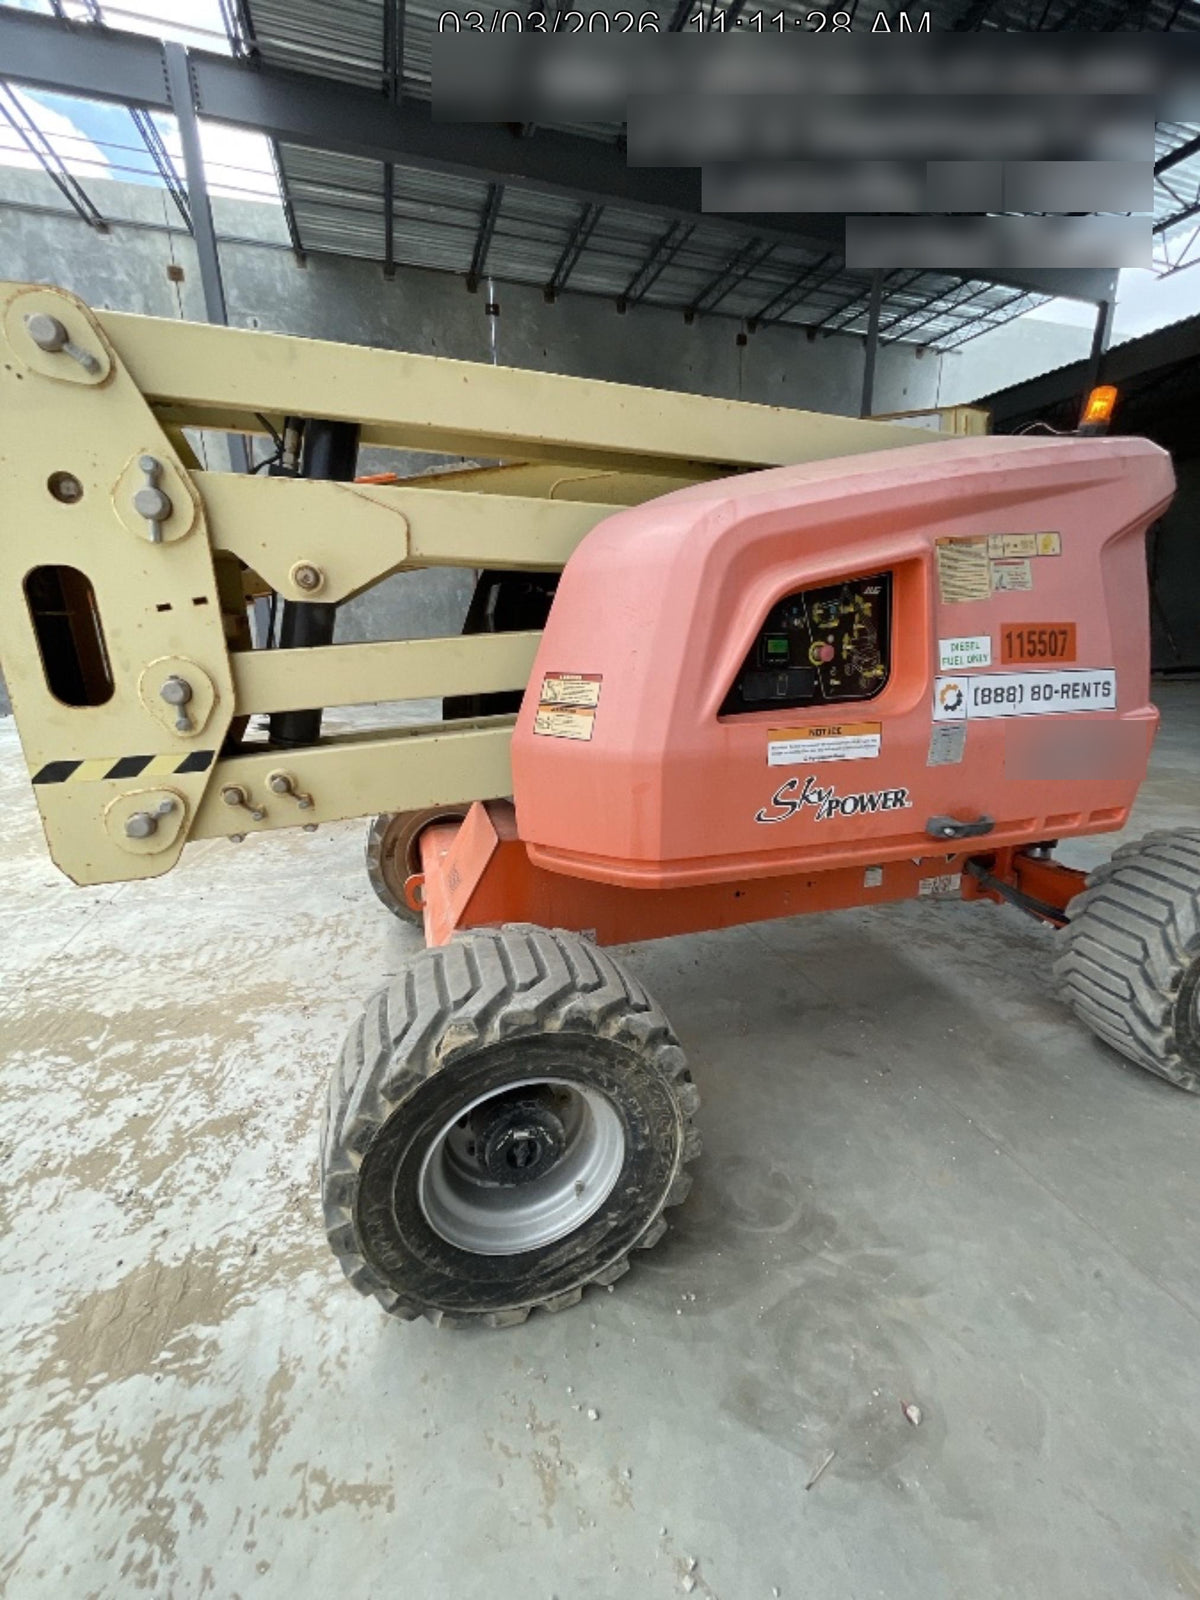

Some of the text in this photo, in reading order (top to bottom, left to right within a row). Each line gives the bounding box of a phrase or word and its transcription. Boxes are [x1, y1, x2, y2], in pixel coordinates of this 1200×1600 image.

[950, 641, 981, 652] DIESEL
[1005, 630, 1069, 658] 115507
[942, 654, 989, 666] FUEL ONLY
[974, 681, 1112, 706] (888) 80-RENTS
[808, 726, 842, 737] NOTICE
